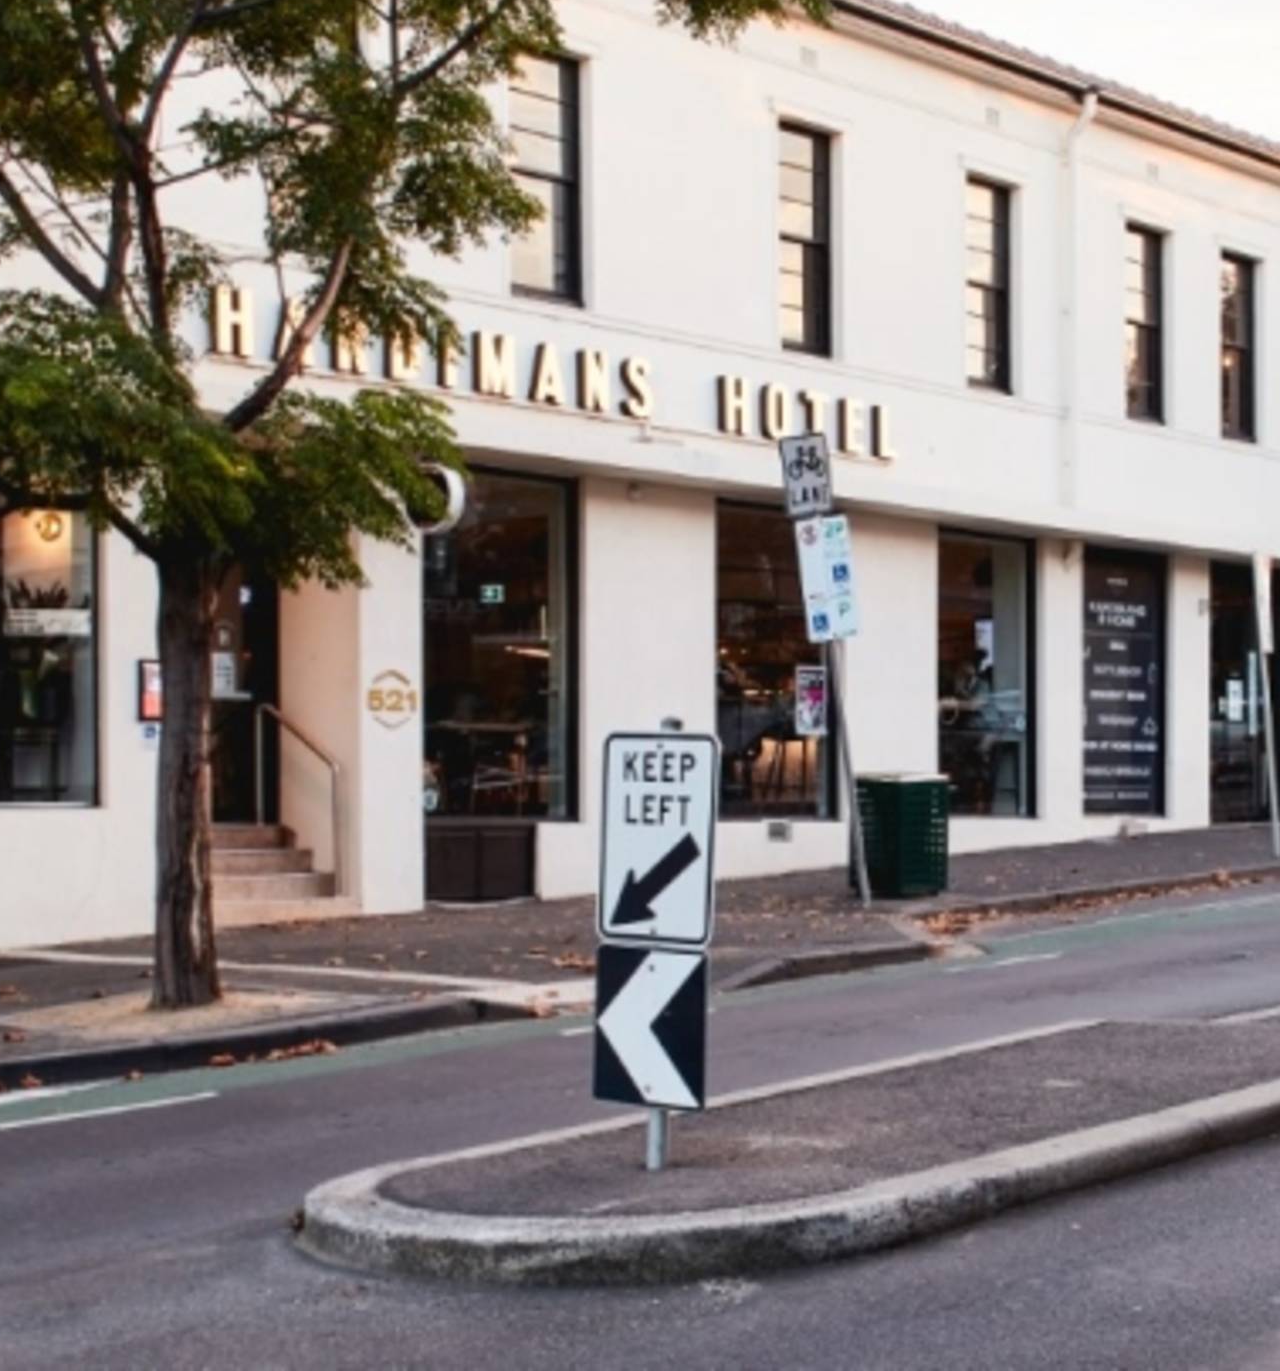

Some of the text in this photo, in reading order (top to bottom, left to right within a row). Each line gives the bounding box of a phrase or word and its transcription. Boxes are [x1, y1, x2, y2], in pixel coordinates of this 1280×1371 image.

[714, 374, 899, 462] HOTEL
[367, 689, 417, 714] 521
[623, 750, 696, 783] KEEP
[625, 794, 691, 826] LEFT
